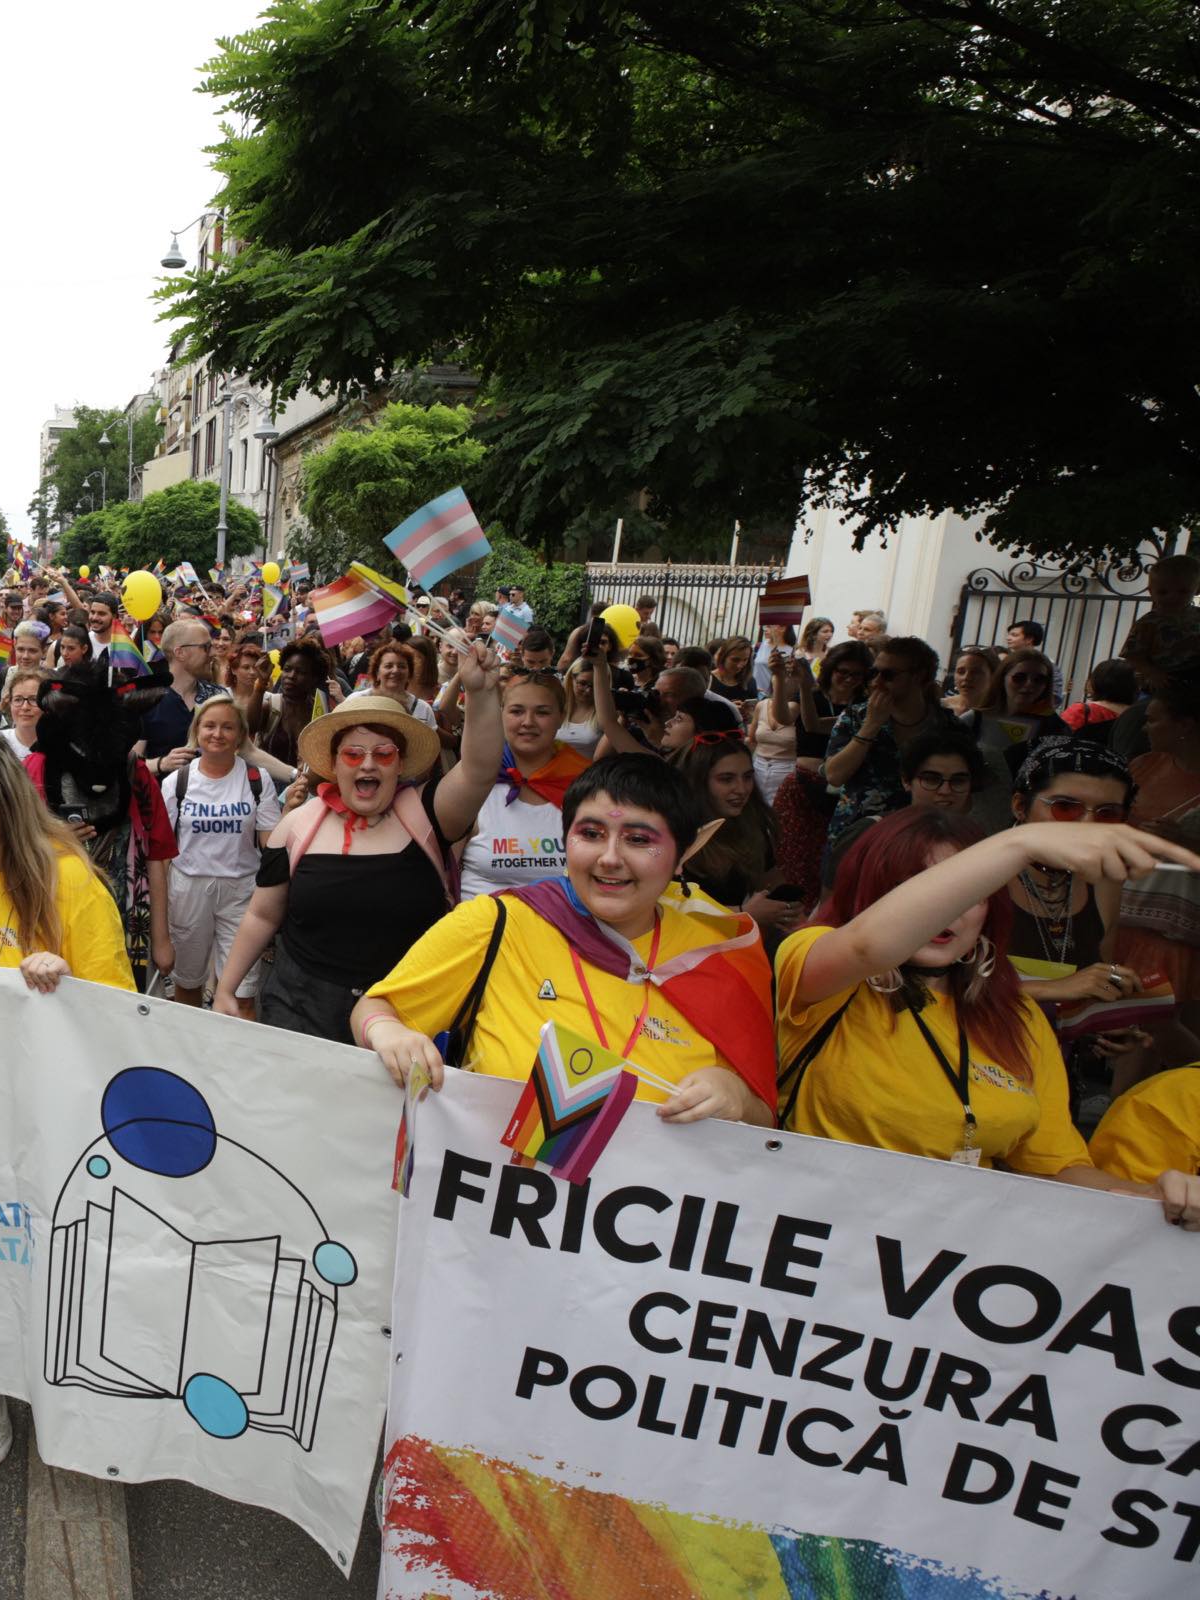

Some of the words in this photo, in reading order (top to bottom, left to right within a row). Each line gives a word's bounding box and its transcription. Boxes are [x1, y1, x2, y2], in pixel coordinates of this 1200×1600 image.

[183, 802, 252, 817] FINLAND
[191, 820, 242, 834] SUOMI
[493, 838, 525, 857] ME,
[528, 837, 566, 854] YOU
[491, 858, 557, 868] #TOGETHER
[433, 1149, 833, 1297] FRICILE
[628, 1291, 1058, 1442] CENZURA
[515, 1346, 908, 1486] POLITICĂ
[941, 1442, 1081, 1532] DE
